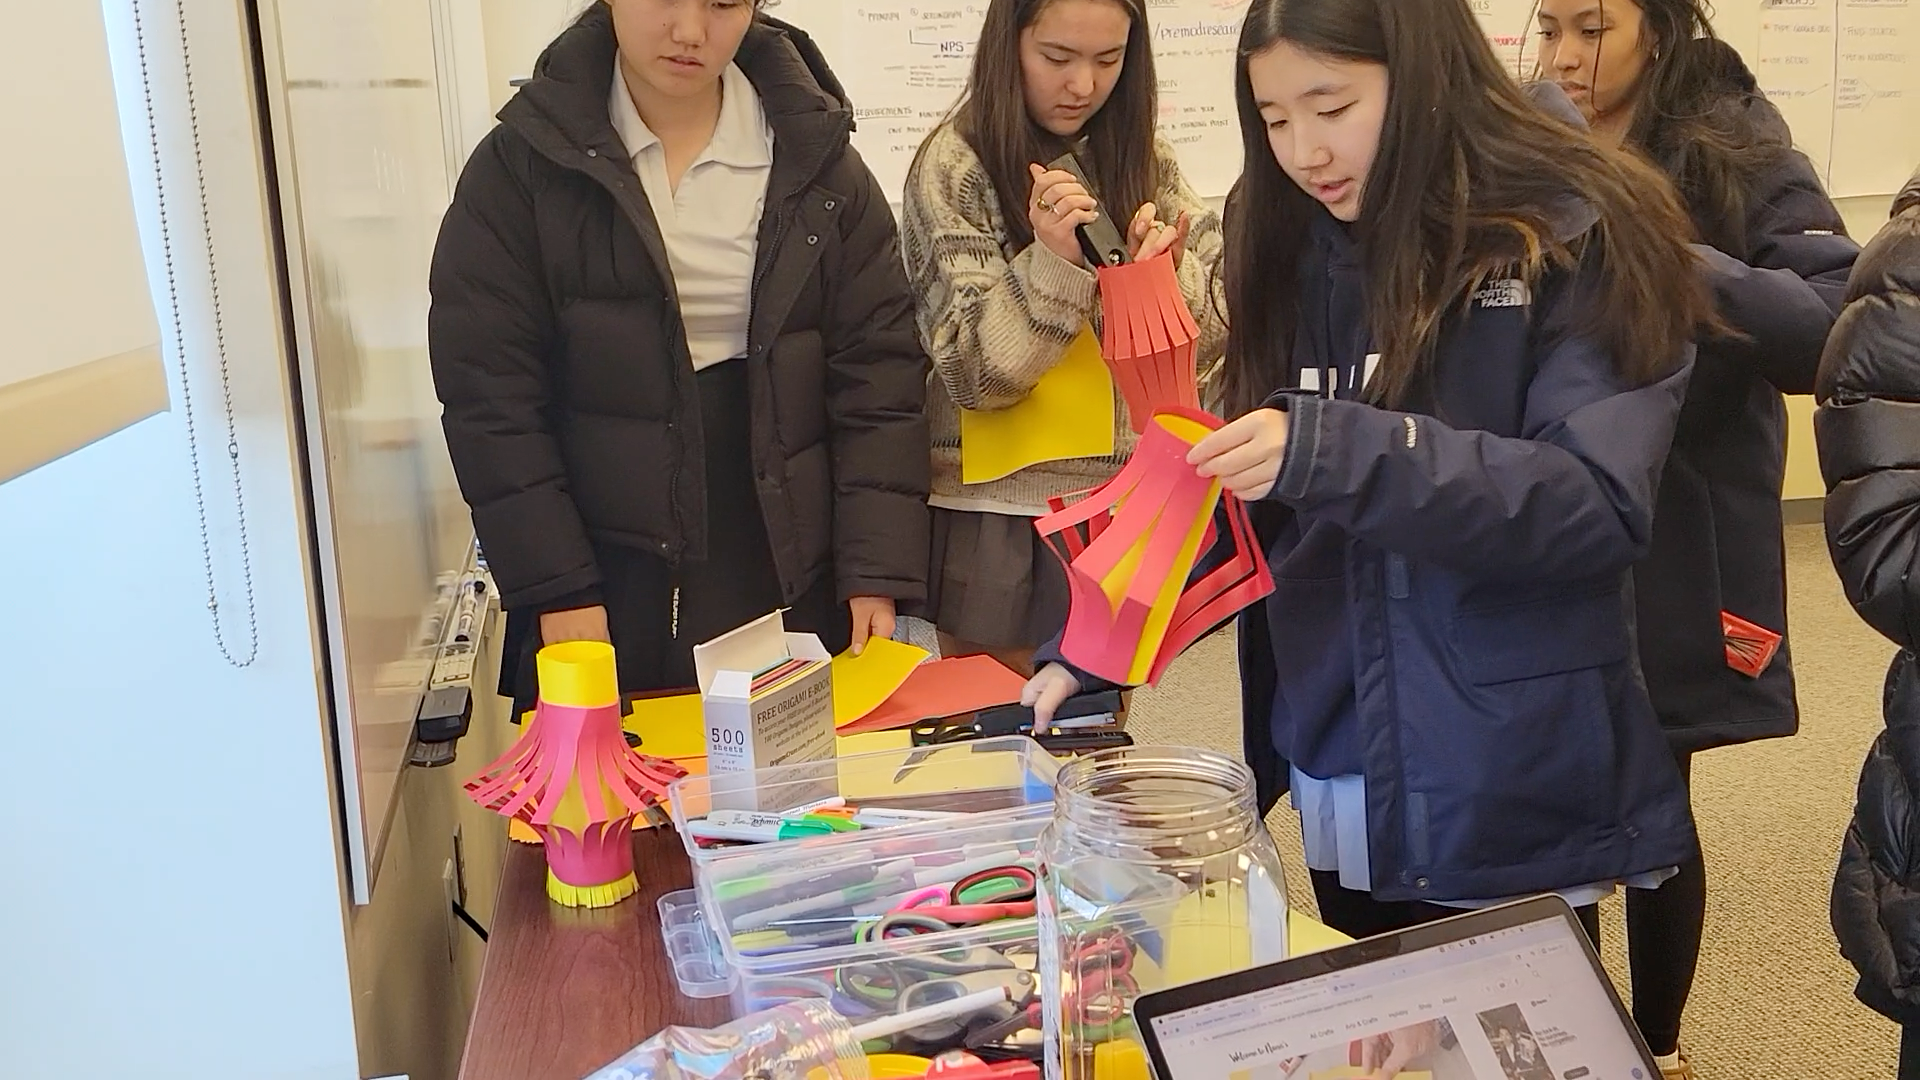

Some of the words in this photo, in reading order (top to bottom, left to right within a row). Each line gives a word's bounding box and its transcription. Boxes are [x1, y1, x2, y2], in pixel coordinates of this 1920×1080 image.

[941, 41, 964, 52] NPS
[1488, 280, 1510, 289] THE
[1481, 297, 1511, 308] FACE
[757, 705, 777, 725] FREE
[777, 688, 807, 714] ORIGAMI
[711, 727, 744, 746] 500
[713, 744, 743, 753] sheets
